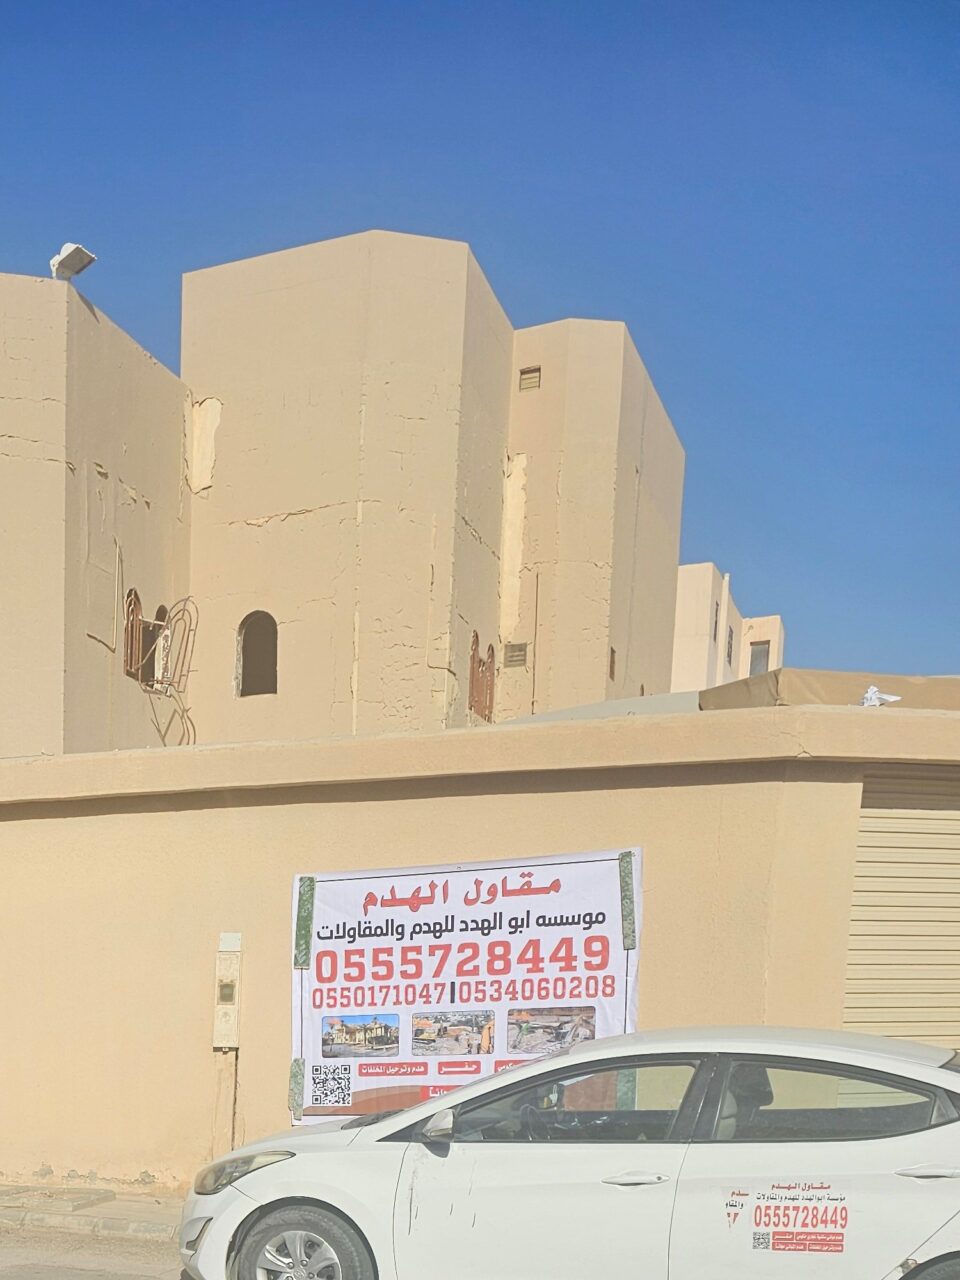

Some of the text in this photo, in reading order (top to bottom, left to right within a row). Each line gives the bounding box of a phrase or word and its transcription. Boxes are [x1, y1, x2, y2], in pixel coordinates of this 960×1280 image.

[362, 871, 562, 916] مقاول الهدم
[316, 910, 607, 944] موسسه ابو الهدد للهدم والمقاولات
[315, 935, 611, 984] 0555728449
[312, 974, 616, 1010] 0550171047 0534060208
[439, 1062, 478, 1075] حفر
[771, 1182, 831, 1191] مقاول الهدم
[754, 1204, 848, 1229] 0555728449
